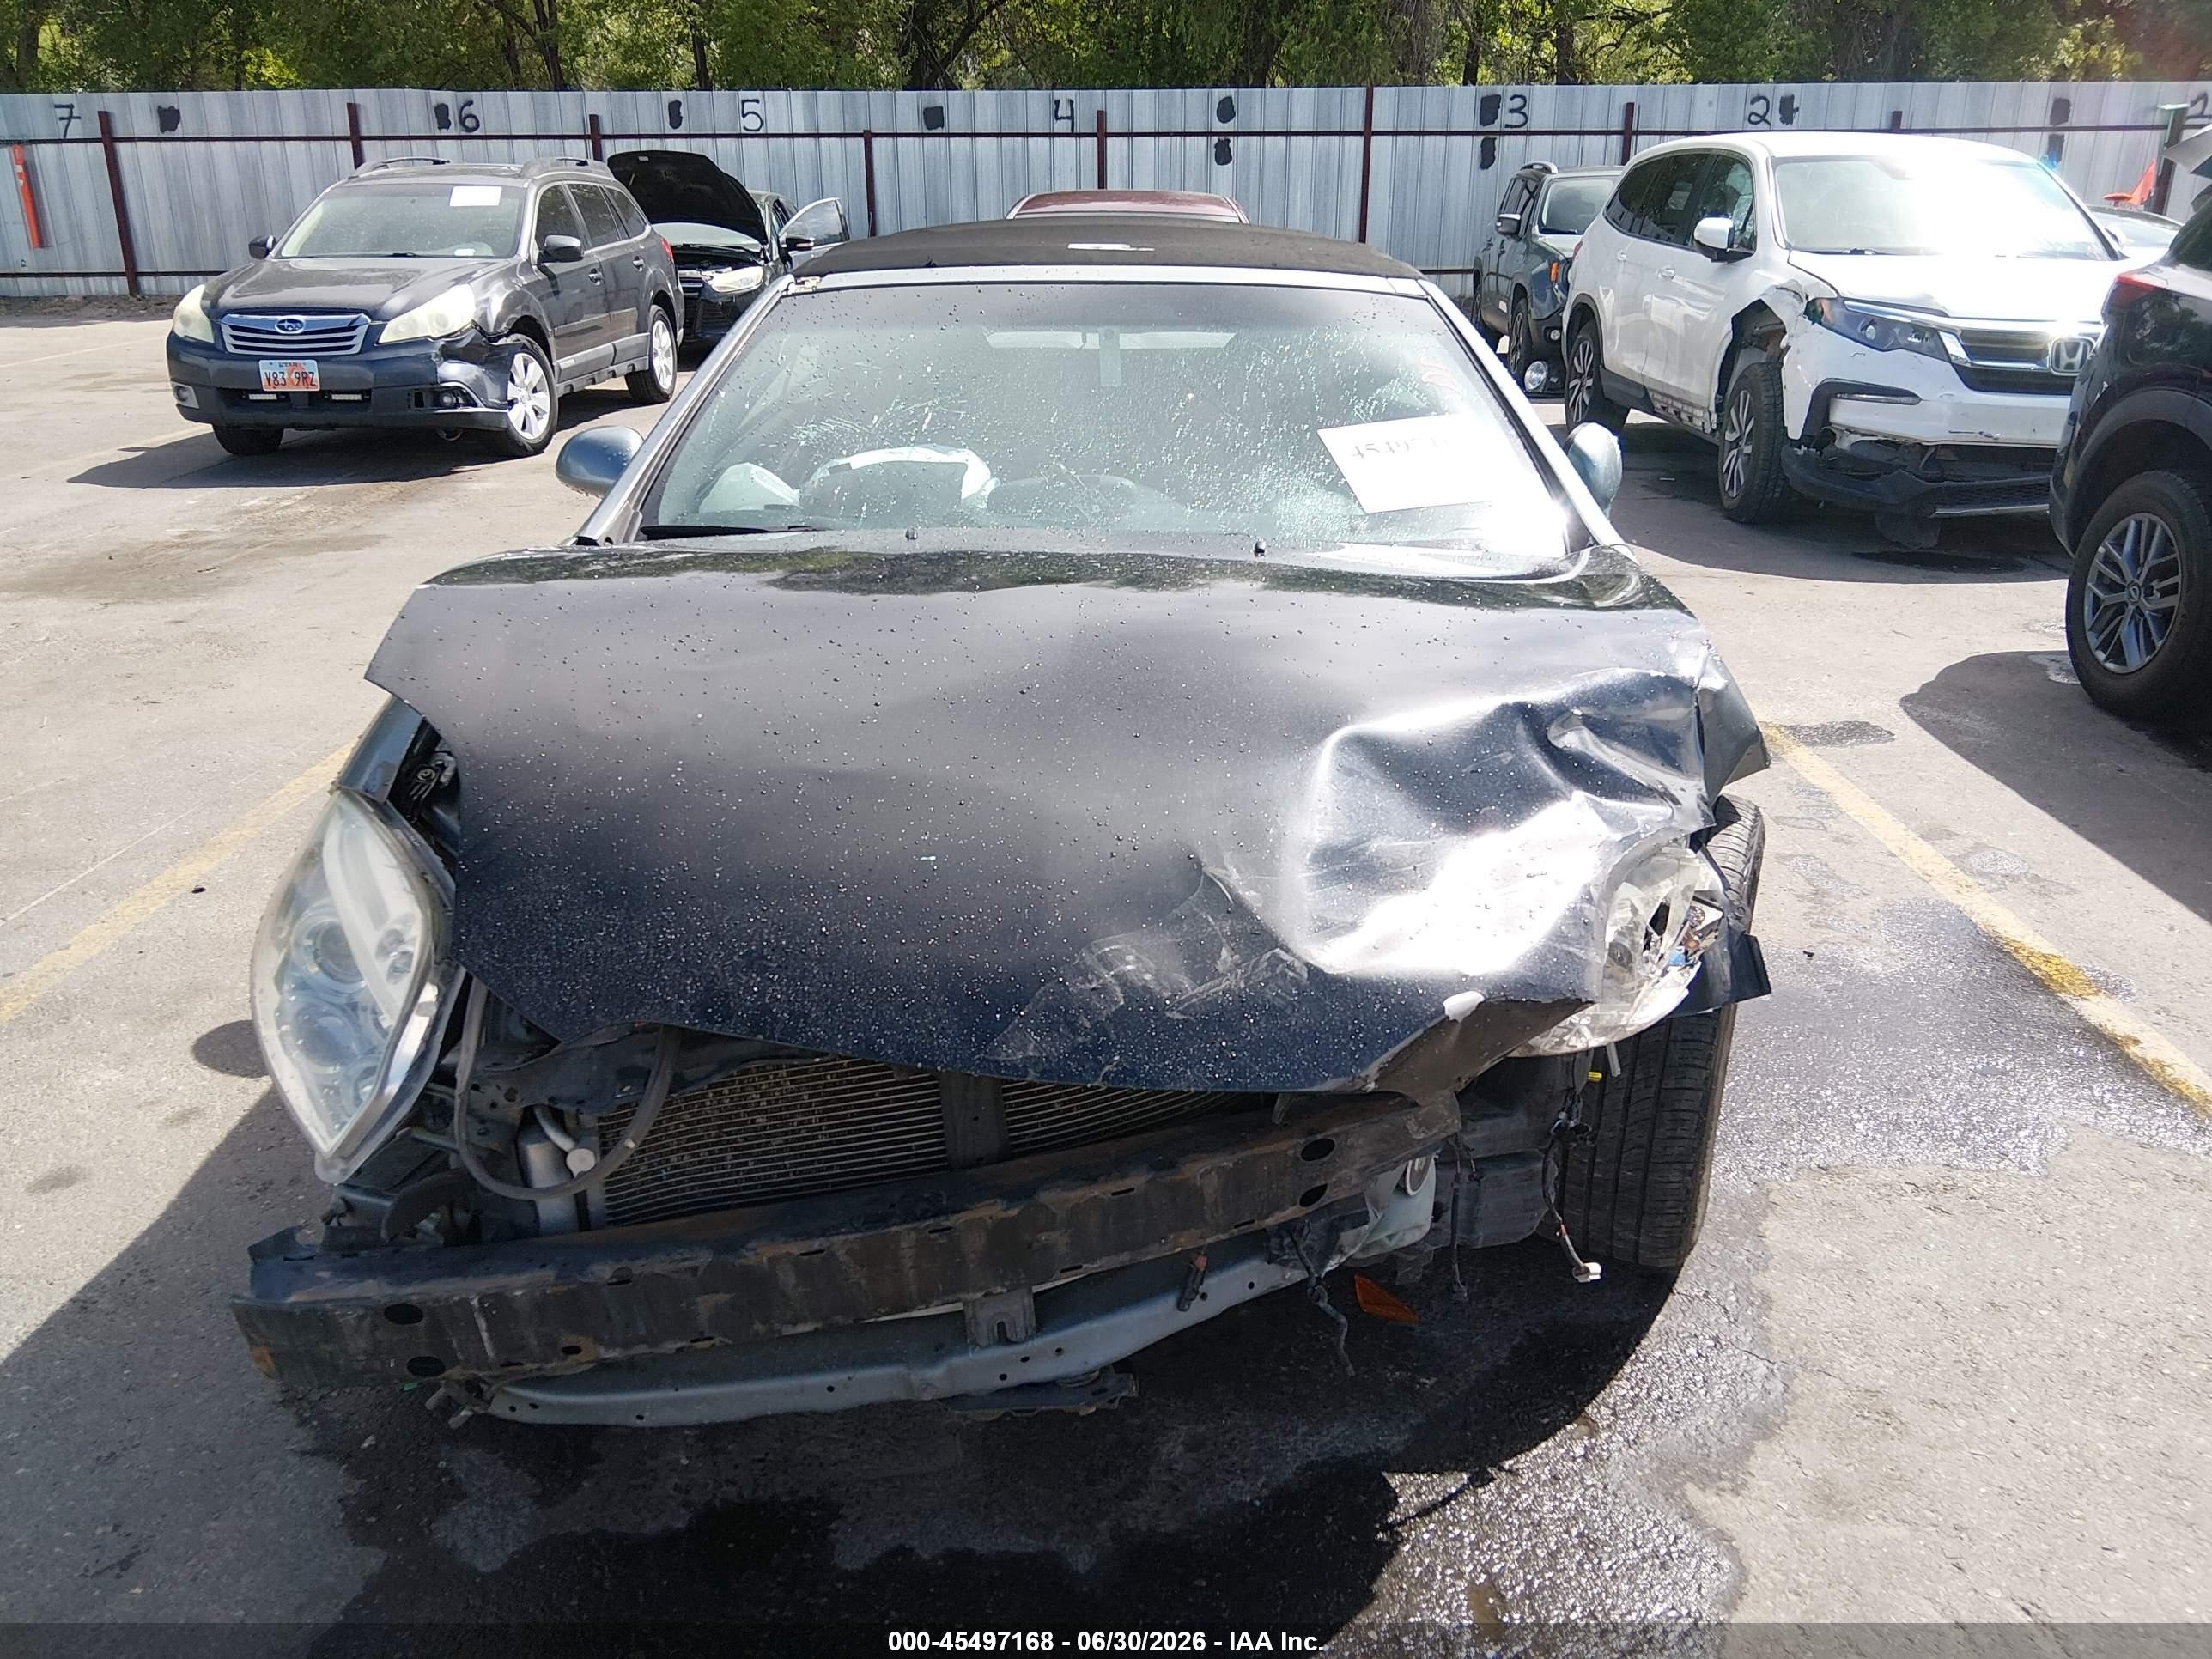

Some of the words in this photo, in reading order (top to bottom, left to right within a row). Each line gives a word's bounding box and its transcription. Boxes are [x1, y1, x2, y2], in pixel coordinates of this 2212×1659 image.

[54, 103, 82, 138] 7
[459, 99, 481, 133] 6
[741, 98, 764, 131] 5
[1054, 98, 1075, 133] 4
[1504, 94, 1528, 129] 3
[1747, 95, 1772, 127] 2
[264, 371, 287, 386] V83
[294, 371, 317, 386] 9RZ
